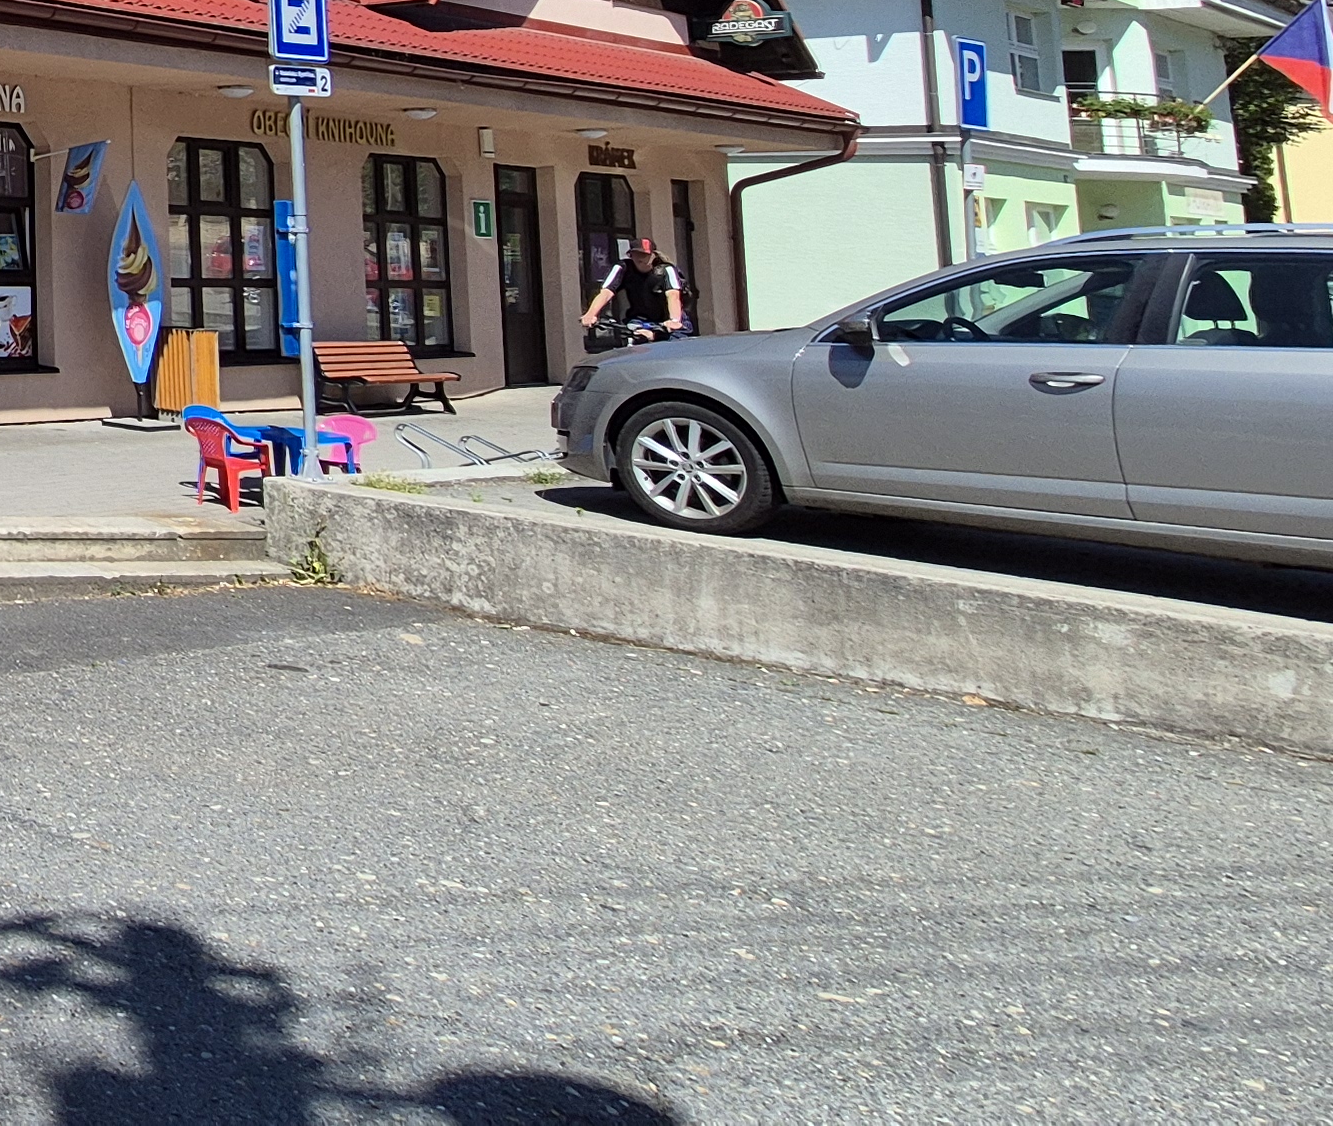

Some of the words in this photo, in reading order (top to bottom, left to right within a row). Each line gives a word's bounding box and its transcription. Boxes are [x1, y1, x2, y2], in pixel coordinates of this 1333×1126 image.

[711, 18, 779, 33] RADEGAST
[320, 75, 328, 92] 2
[962, 49, 981, 100] P
[251, 109, 310, 138] OBEÍ
[316, 116, 395, 146] KNIHOVNA
